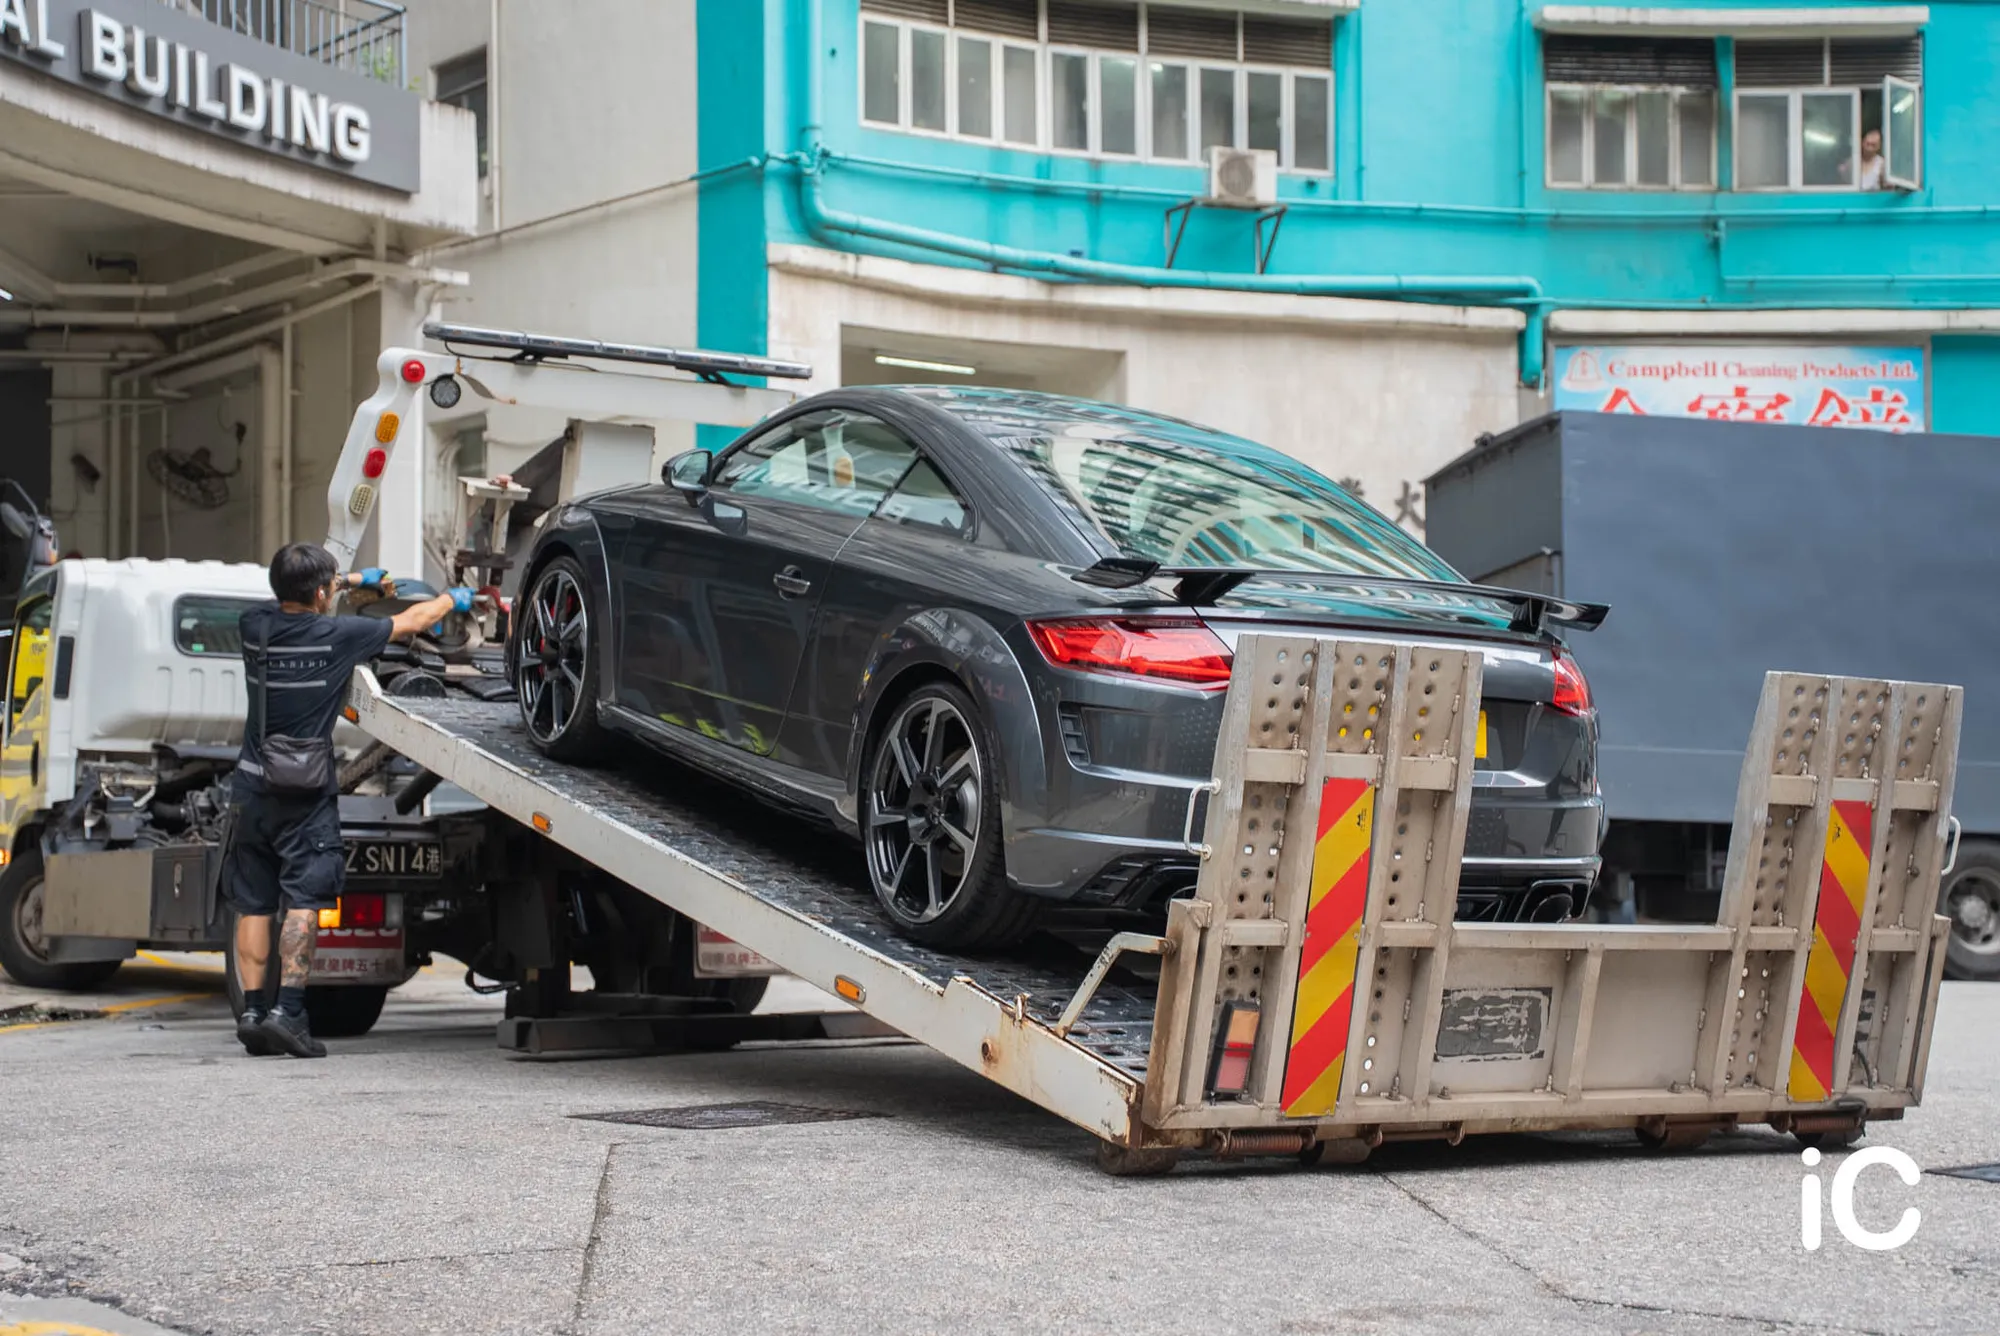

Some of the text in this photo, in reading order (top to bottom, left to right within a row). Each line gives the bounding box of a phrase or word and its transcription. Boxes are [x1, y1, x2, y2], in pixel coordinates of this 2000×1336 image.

[87, 8, 371, 163] BUILDING
[1608, 361, 1718, 381] Campbell
[1723, 363, 1798, 381] Cleaning
[1803, 364, 1877, 381] Products
[1880, 363, 1918, 380] Ltd.
